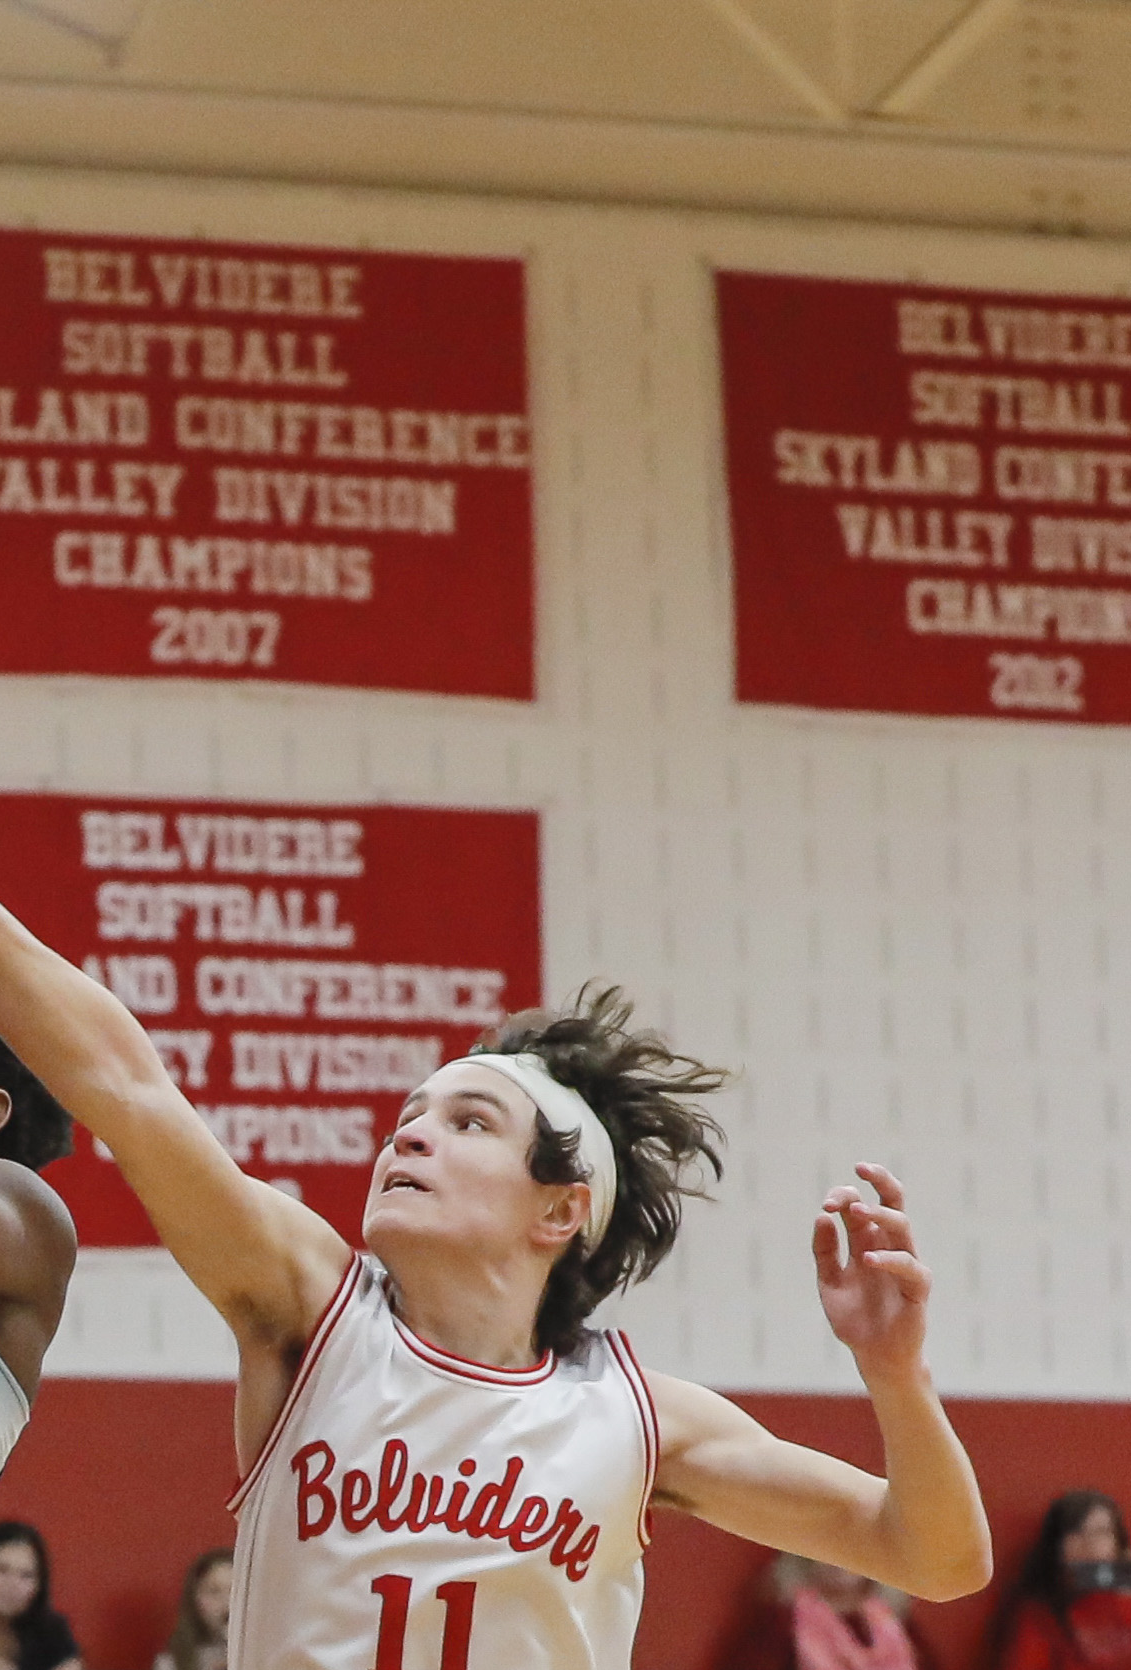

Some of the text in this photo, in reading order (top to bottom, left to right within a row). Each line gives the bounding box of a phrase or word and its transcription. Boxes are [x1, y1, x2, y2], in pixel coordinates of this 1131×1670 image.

[42, 248, 364, 319] BELVIDERE
[61, 318, 349, 387] SOFTBALL
[174, 392, 533, 468] CONFERENCE
[773, 427, 982, 496] SKYLAND
[213, 465, 458, 536] DIVISION
[53, 530, 373, 601] CHAMPIONS
[836, 503, 1014, 569] VALLEY
[150, 607, 281, 667] 2007
[78, 810, 365, 878] BELVIDERE
[96, 881, 356, 949] SOFTBALL
[195, 955, 508, 1025] CONFERENCE
[230, 1031, 443, 1093] DIVISION
[290, 1437, 601, 1582] Belvidere
